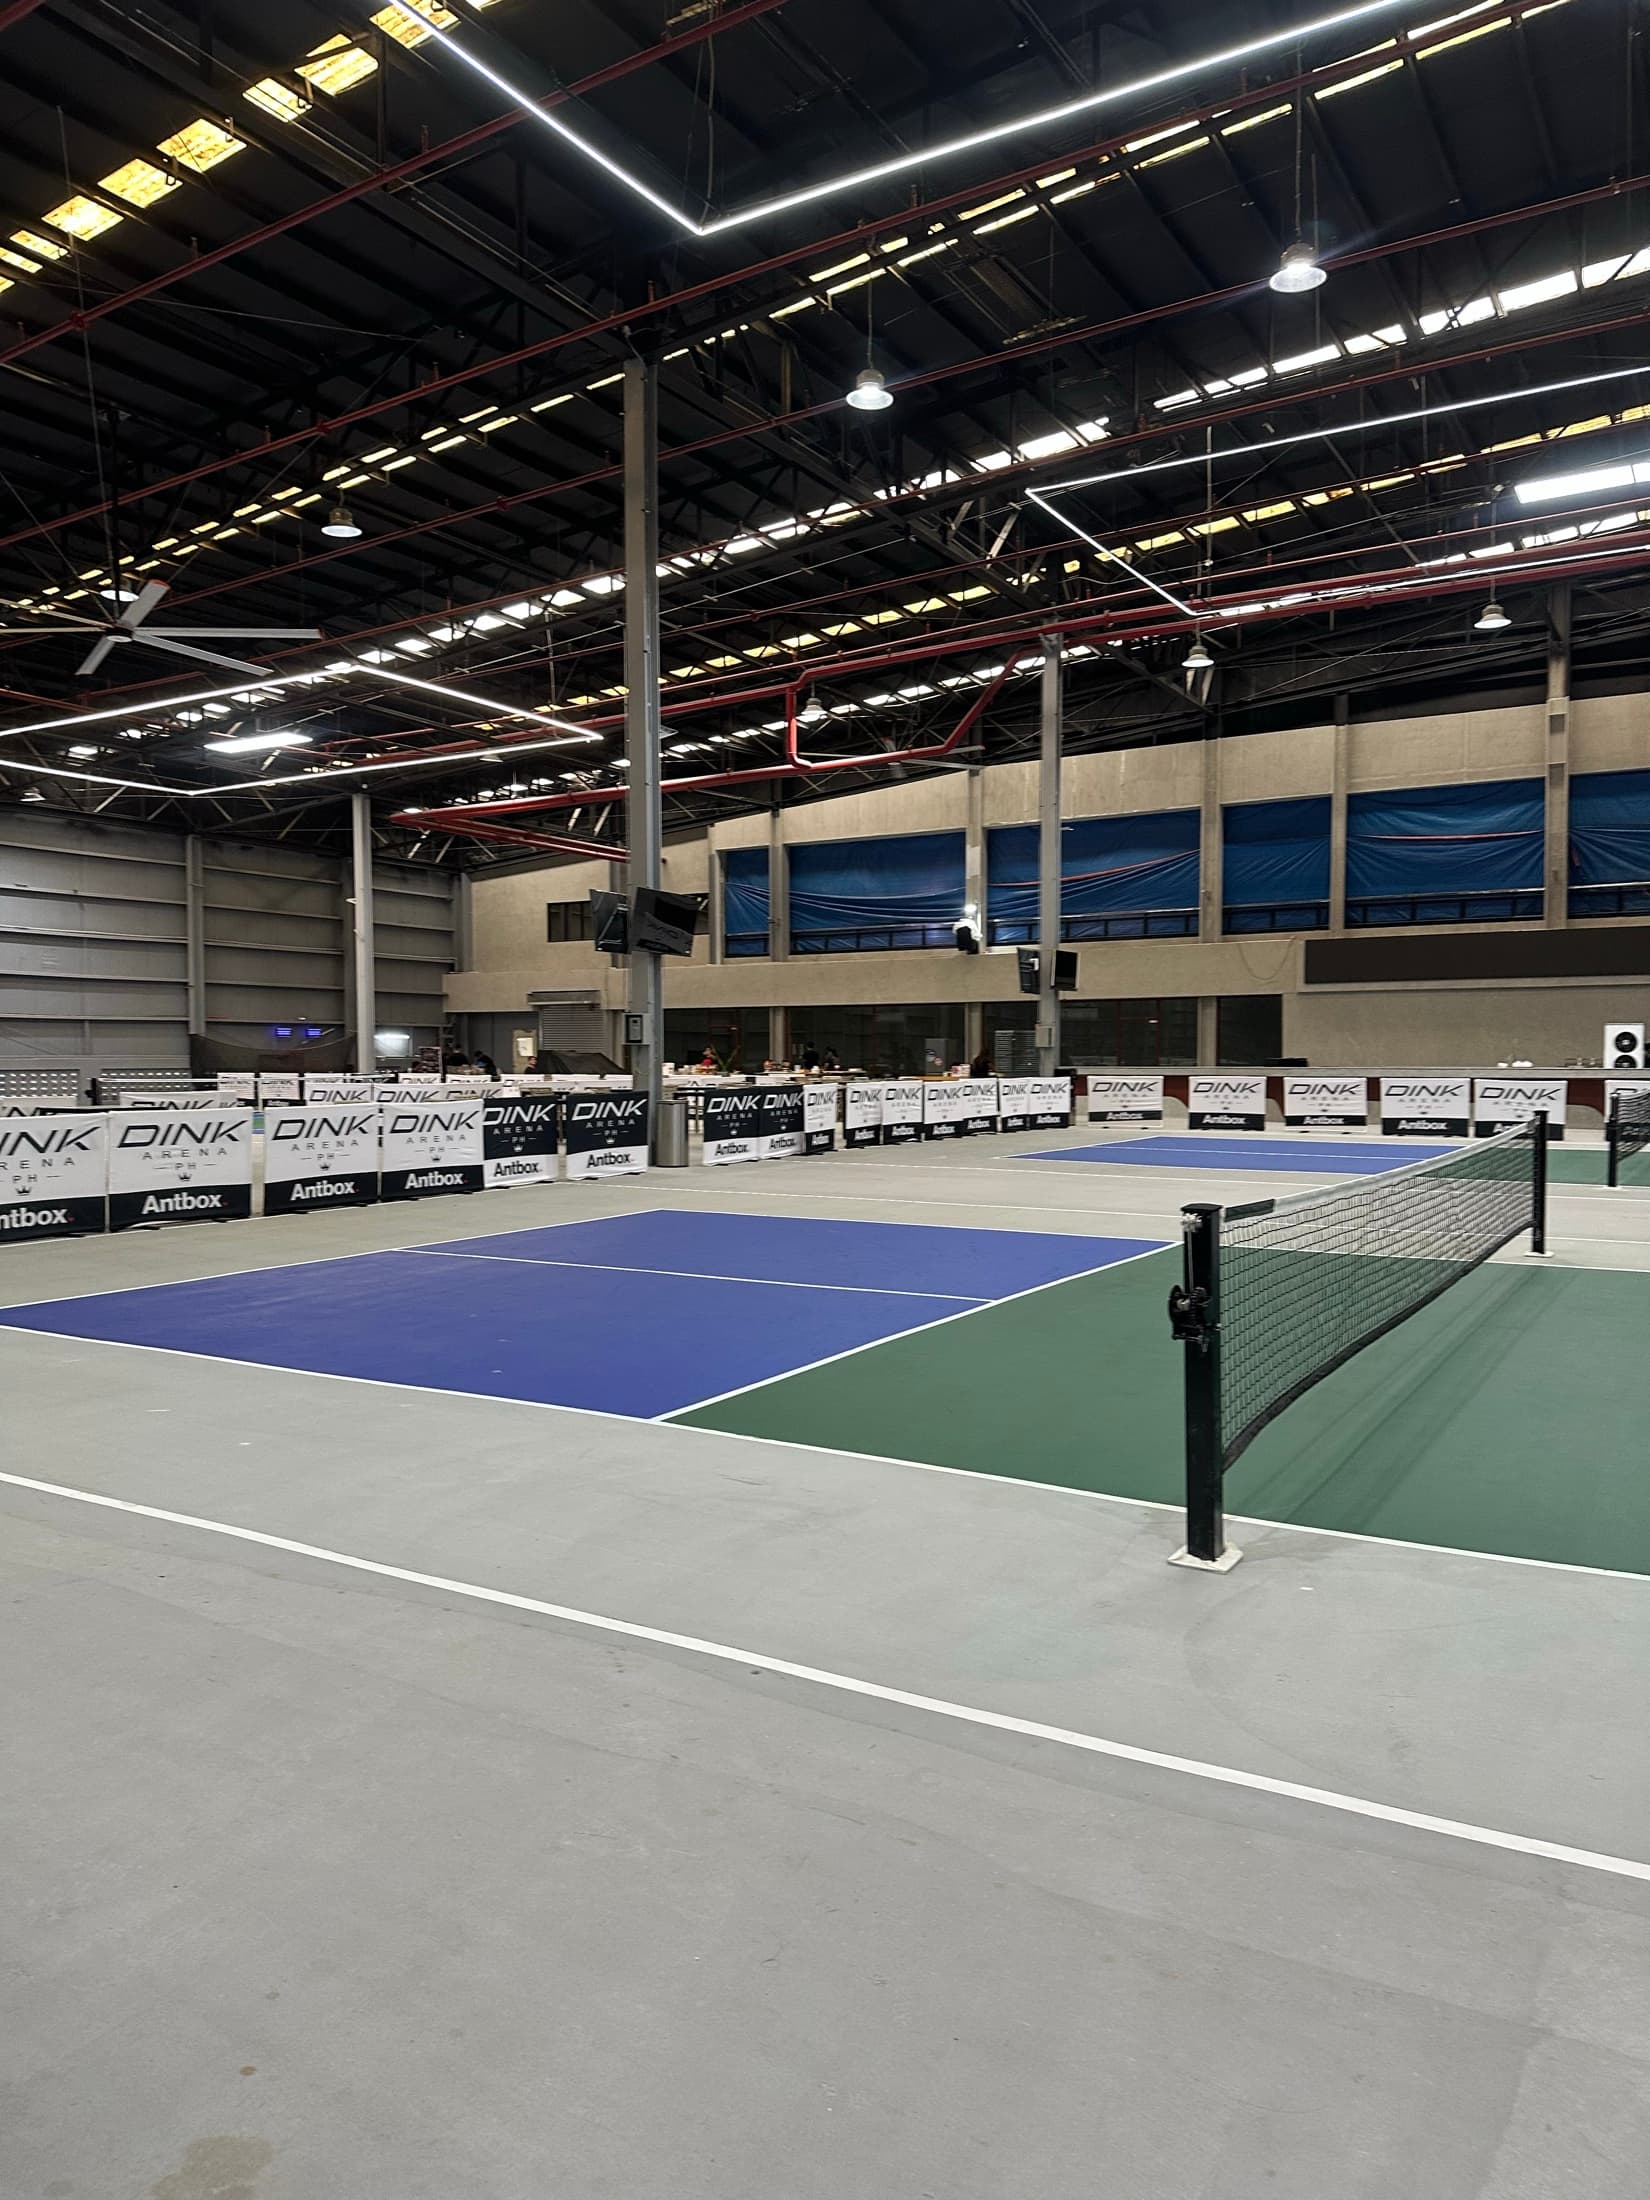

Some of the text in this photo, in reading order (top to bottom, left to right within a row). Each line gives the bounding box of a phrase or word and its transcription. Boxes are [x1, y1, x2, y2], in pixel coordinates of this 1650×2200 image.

[1092, 1081, 1159, 1093] DINK
[1193, 1082, 1262, 1094] DINK
[1288, 1083, 1361, 1095] DINK
[1384, 1084, 1465, 1097] DINK
[1479, 1086, 1562, 1101] DINK
[762, 1092, 804, 1109] DINK
[885, 1087, 922, 1101] DINK
[928, 1087, 964, 1101] DINK
[571, 1099, 648, 1121] DINK
[706, 1095, 762, 1113] DINK
[483, 1103, 556, 1126] DINK
[272, 1114, 376, 1141] DINK
[389, 1110, 481, 1134] DINK
[585, 1119, 636, 1129] ARENA
[117, 1120, 249, 1149] DINK
[493, 1125, 544, 1135] ARENA
[0, 1126, 101, 1156] INK
[290, 1140, 359, 1151] ARENA
[405, 1134, 466, 1144] ARENA
[142, 1147, 228, 1160] ARENA
[0, 1157, 76, 1170] RENA
[175, 1162, 197, 1170] PH
[12, 1174, 38, 1182] PH
